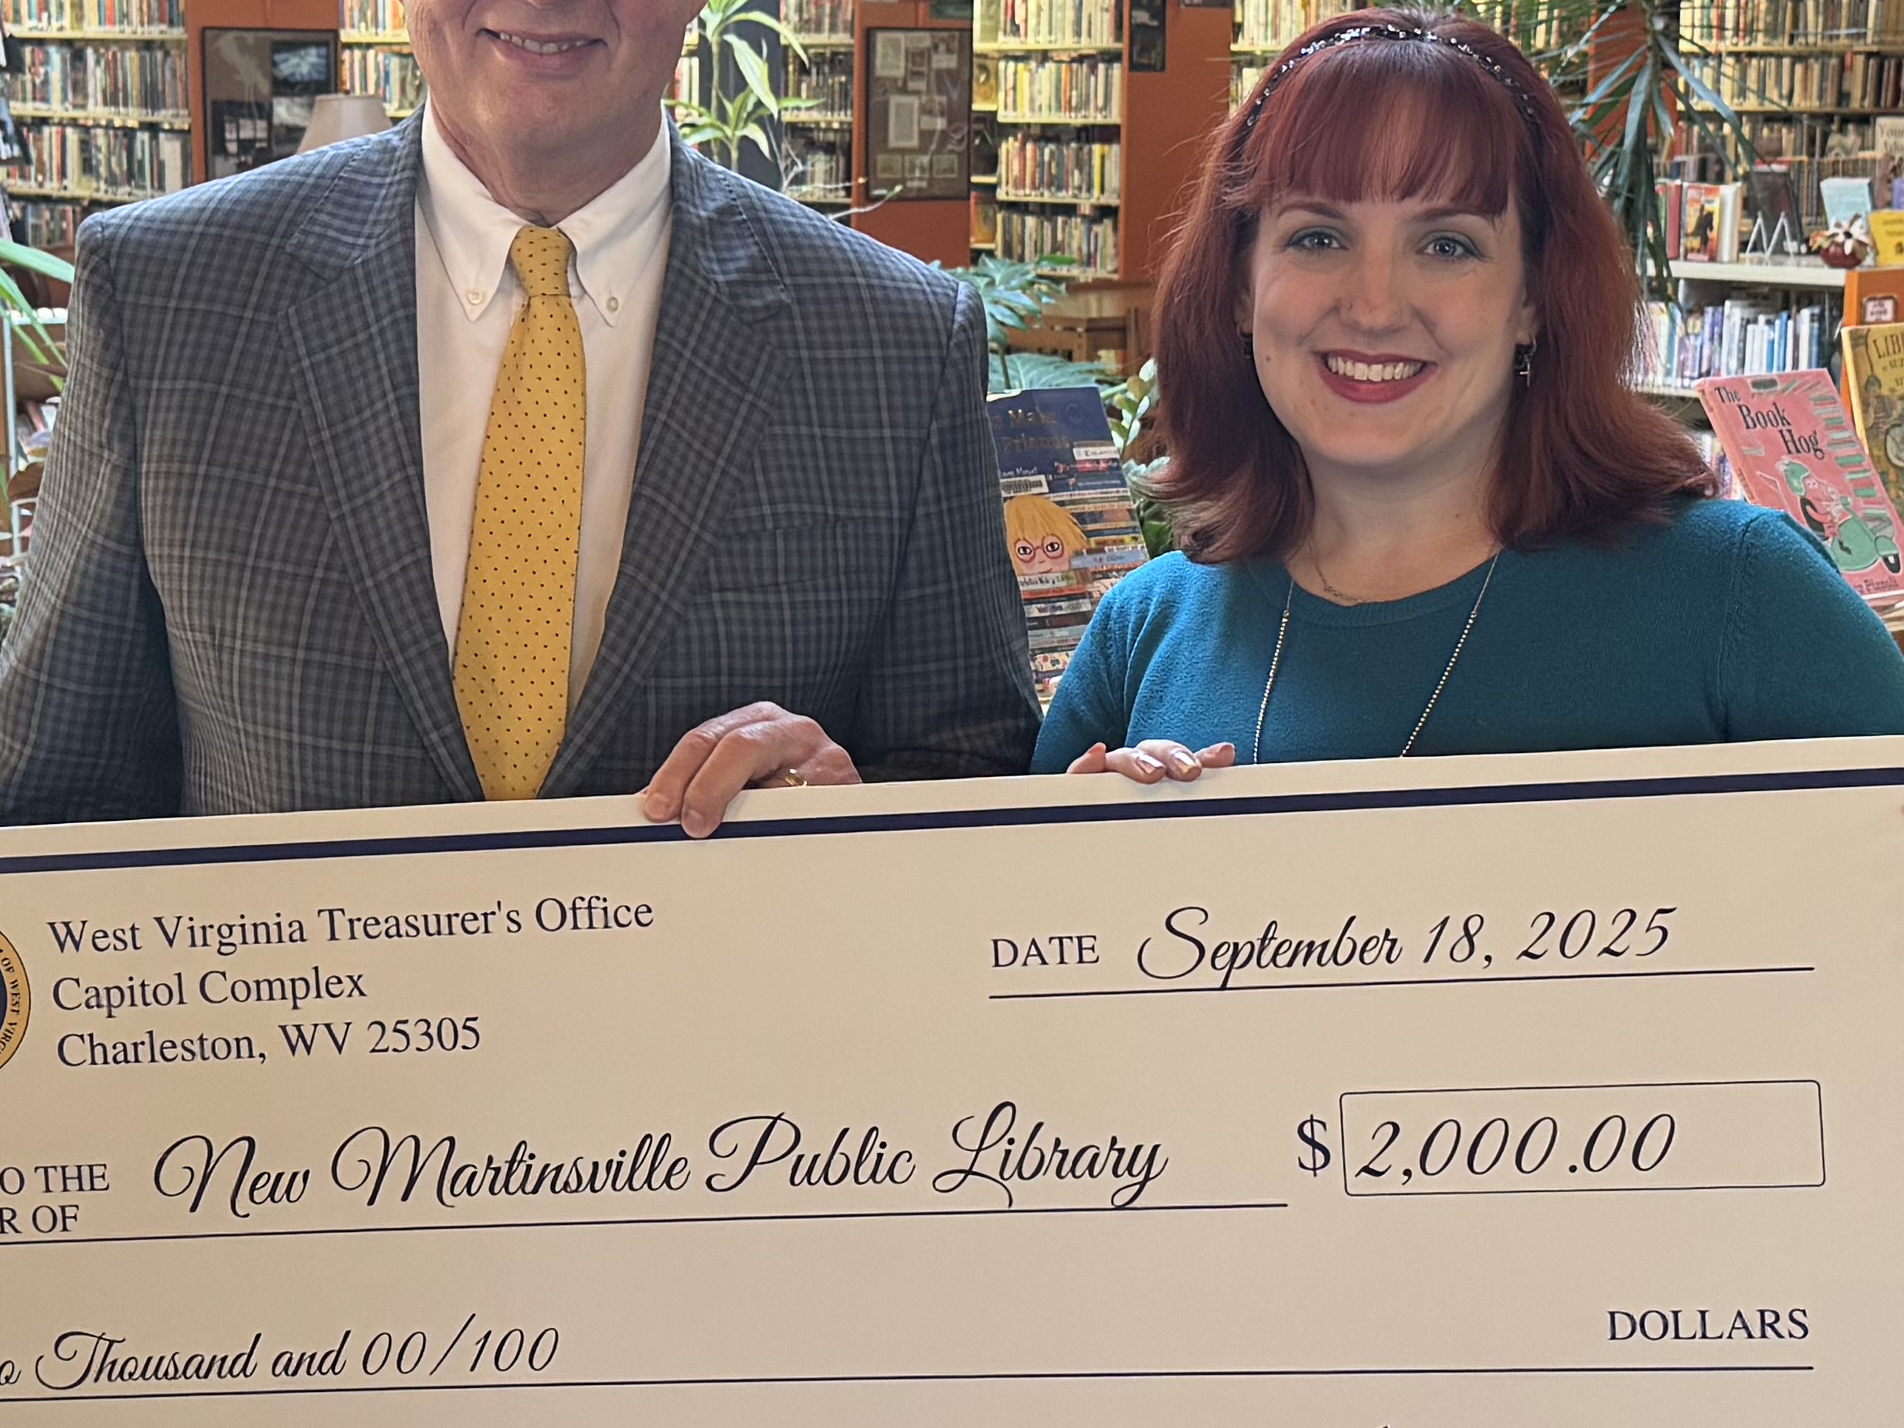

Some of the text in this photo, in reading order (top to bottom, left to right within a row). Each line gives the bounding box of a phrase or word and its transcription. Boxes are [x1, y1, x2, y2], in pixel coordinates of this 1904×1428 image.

[1714, 386, 1743, 404] The
[1737, 403, 1793, 432] Book
[1779, 428, 1826, 461] Hog
[47, 897, 656, 959] West Virginia Treasurer's Office
[990, 906, 1678, 992] DATE September 18, 2025
[0, 956, 15, 975] OF
[8, 979, 21, 1016] WEST
[51, 968, 368, 1024] Capitol Complex
[56, 1015, 482, 1072] Charleston, WV 25305
[33, 1162, 111, 1196] THE
[153, 1100, 1678, 1219] New Martinsville Public Library $ 2,000.00
[29, 1202, 82, 1235] OF
[34, 1330, 258, 1390] Thousand
[269, 1328, 349, 1383] and
[359, 1311, 561, 1380] 00/100
[1606, 1307, 1811, 1344] DOLLARS
